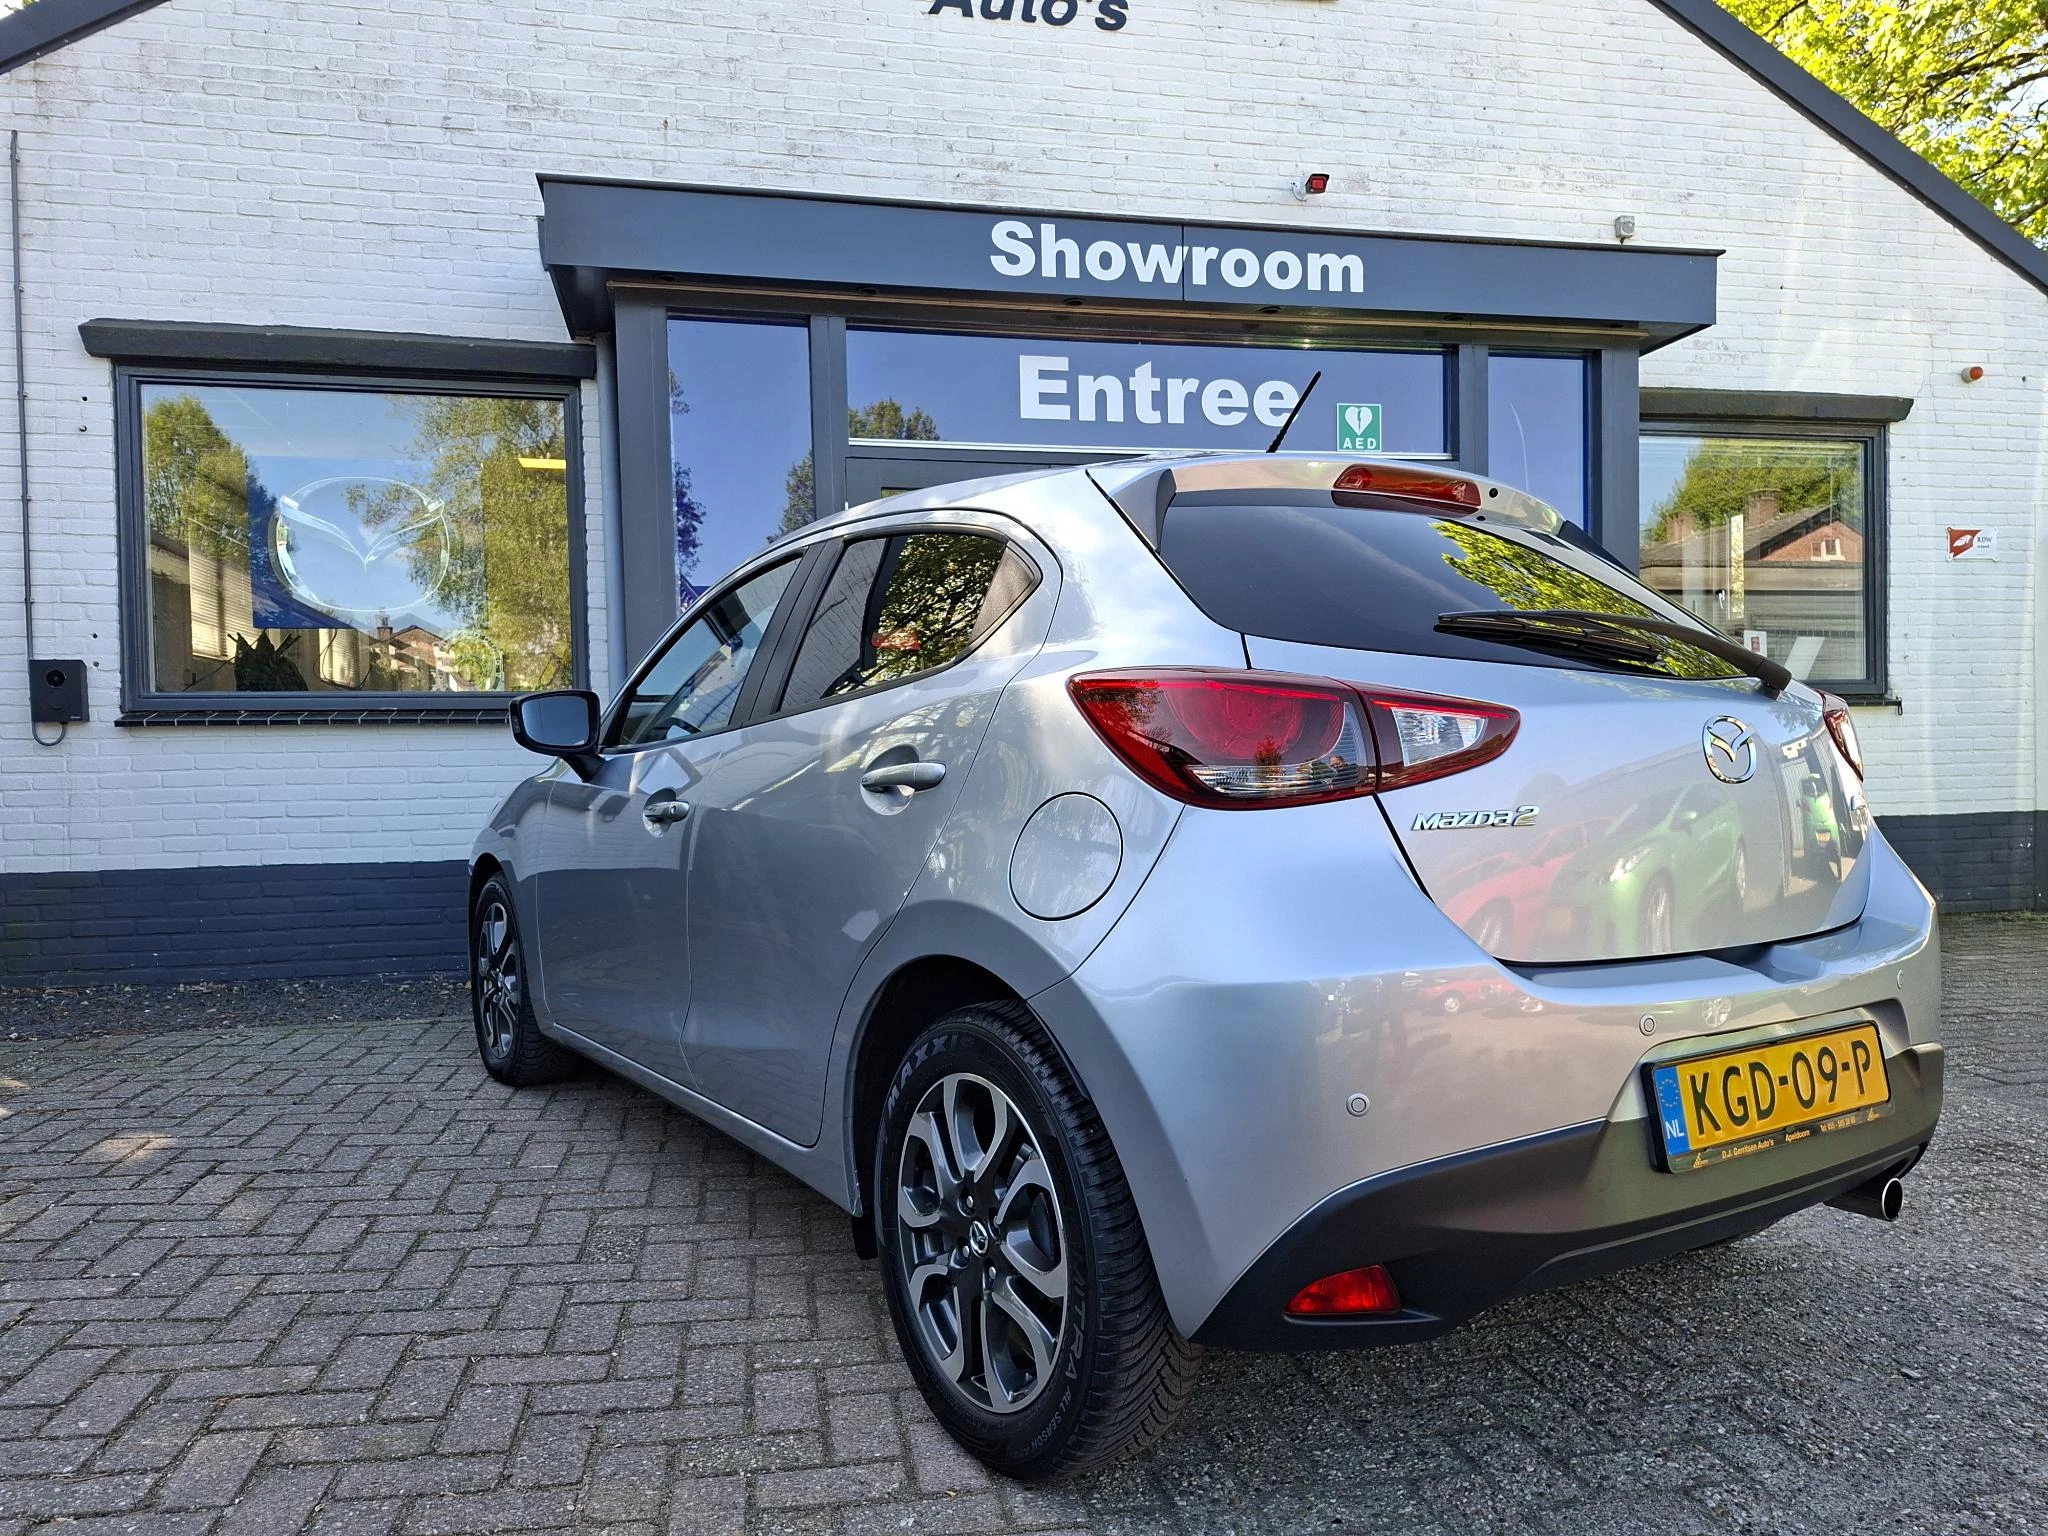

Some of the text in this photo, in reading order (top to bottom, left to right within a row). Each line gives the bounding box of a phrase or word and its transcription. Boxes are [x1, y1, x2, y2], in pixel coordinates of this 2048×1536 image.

[928, 0, 1129, 31] utos
[990, 220, 1364, 293] Showroom
[1019, 355, 1300, 427] Entree
[1343, 437, 1377, 450] AED
[1689, 1039, 1871, 1136] KGD-09-P
[1665, 1118, 1685, 1139] NL
[1030, 1385, 1072, 1451] ALL SEASON
